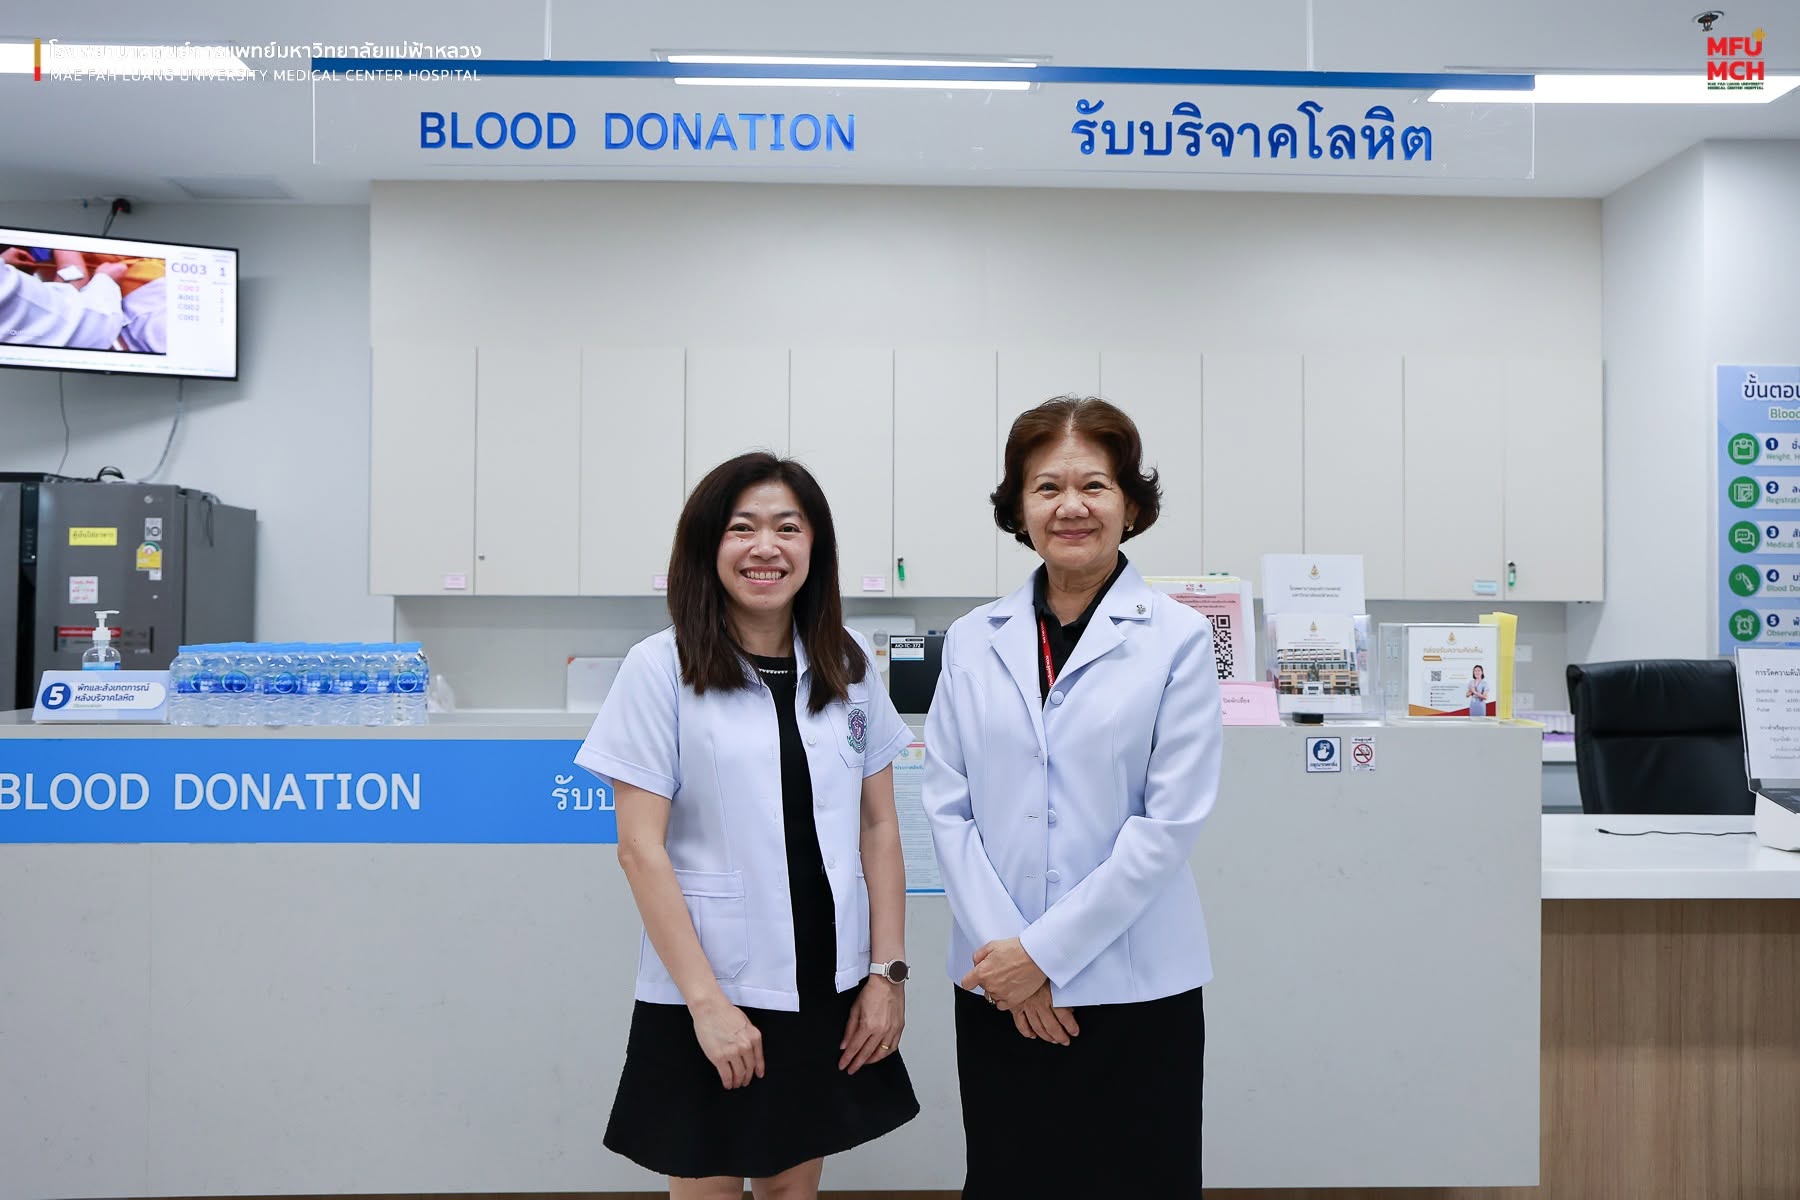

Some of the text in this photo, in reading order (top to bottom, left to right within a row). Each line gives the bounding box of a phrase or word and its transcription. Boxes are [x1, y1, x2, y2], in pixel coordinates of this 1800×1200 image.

[420, 111, 855, 151] BLOOD DONATION
[1071, 98, 1433, 161] รับบริจาคโลหิต
[171, 262, 207, 275] C003
[48, 685, 65, 705] 5
[74, 693, 135, 702] หลังบริจาคโลหิต
[0, 772, 421, 811] BLOOD DONATION
